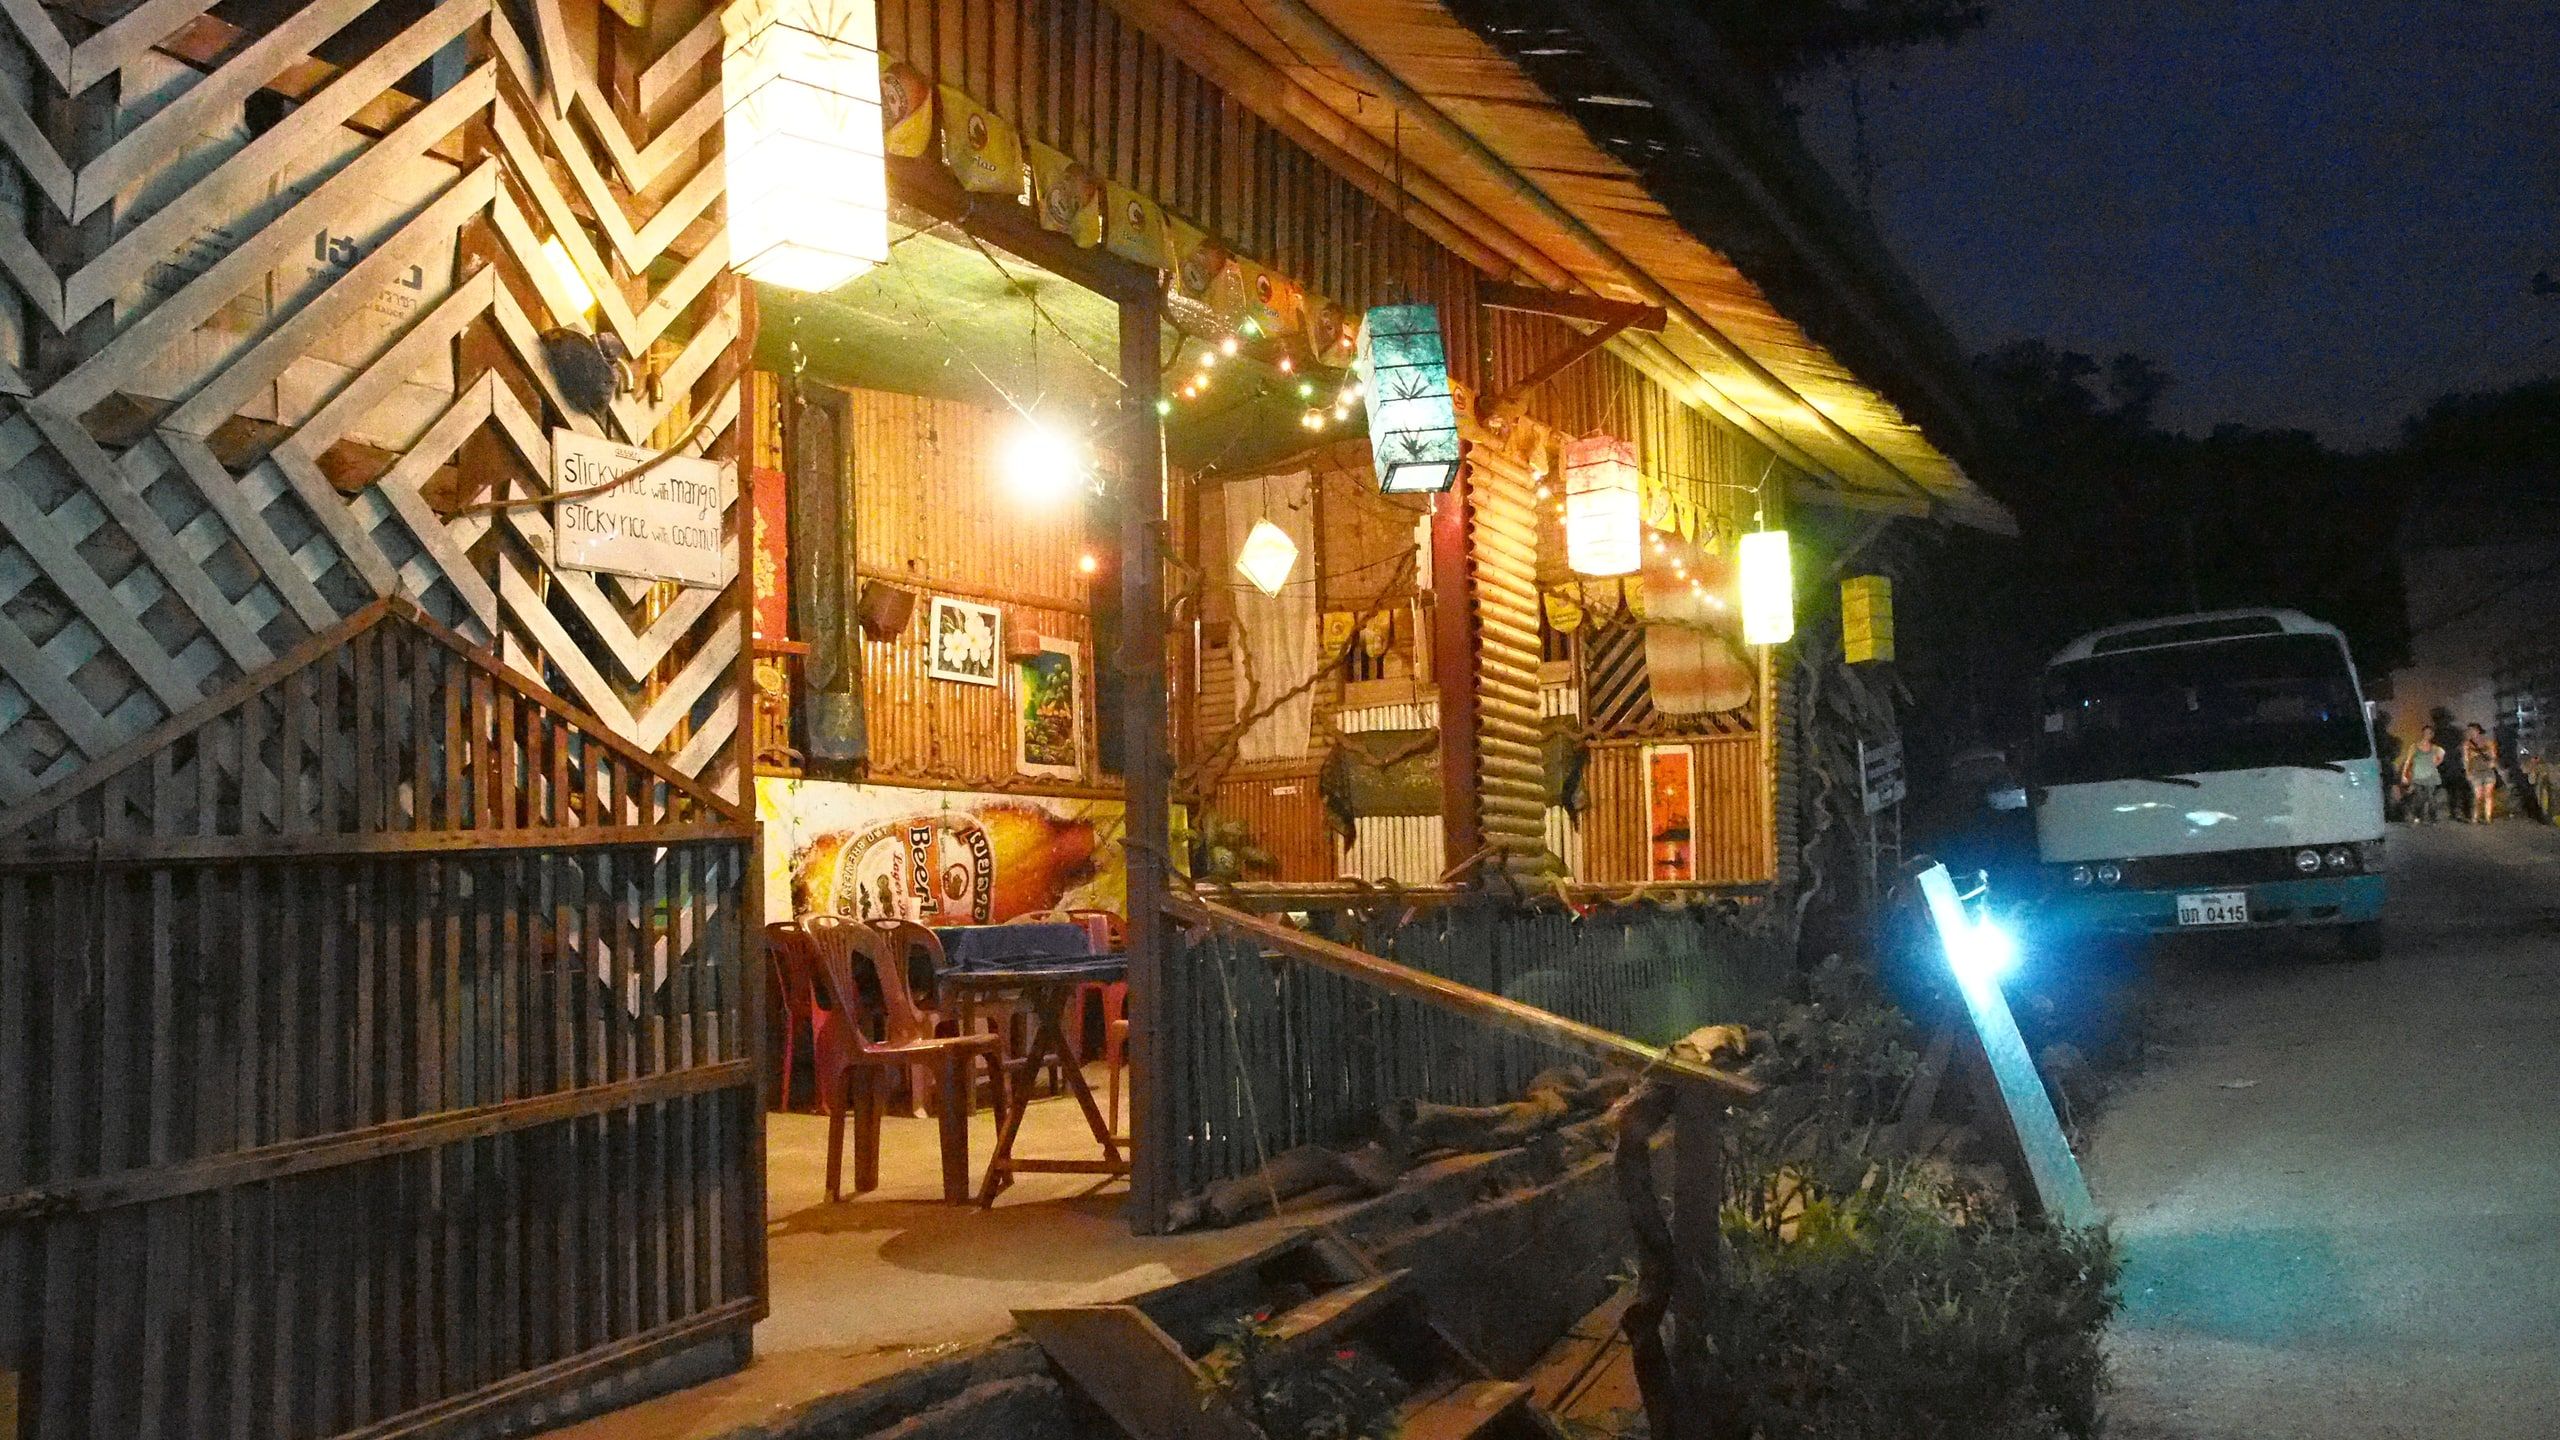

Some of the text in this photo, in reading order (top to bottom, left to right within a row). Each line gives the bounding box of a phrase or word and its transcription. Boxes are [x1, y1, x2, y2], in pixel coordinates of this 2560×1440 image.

[670, 478, 717, 521] mango
[619, 513, 649, 540] rice
[843, 841, 866, 901] BREWERY
[891, 851, 904, 896] Lager
[2206, 905, 2244, 922] 0415
